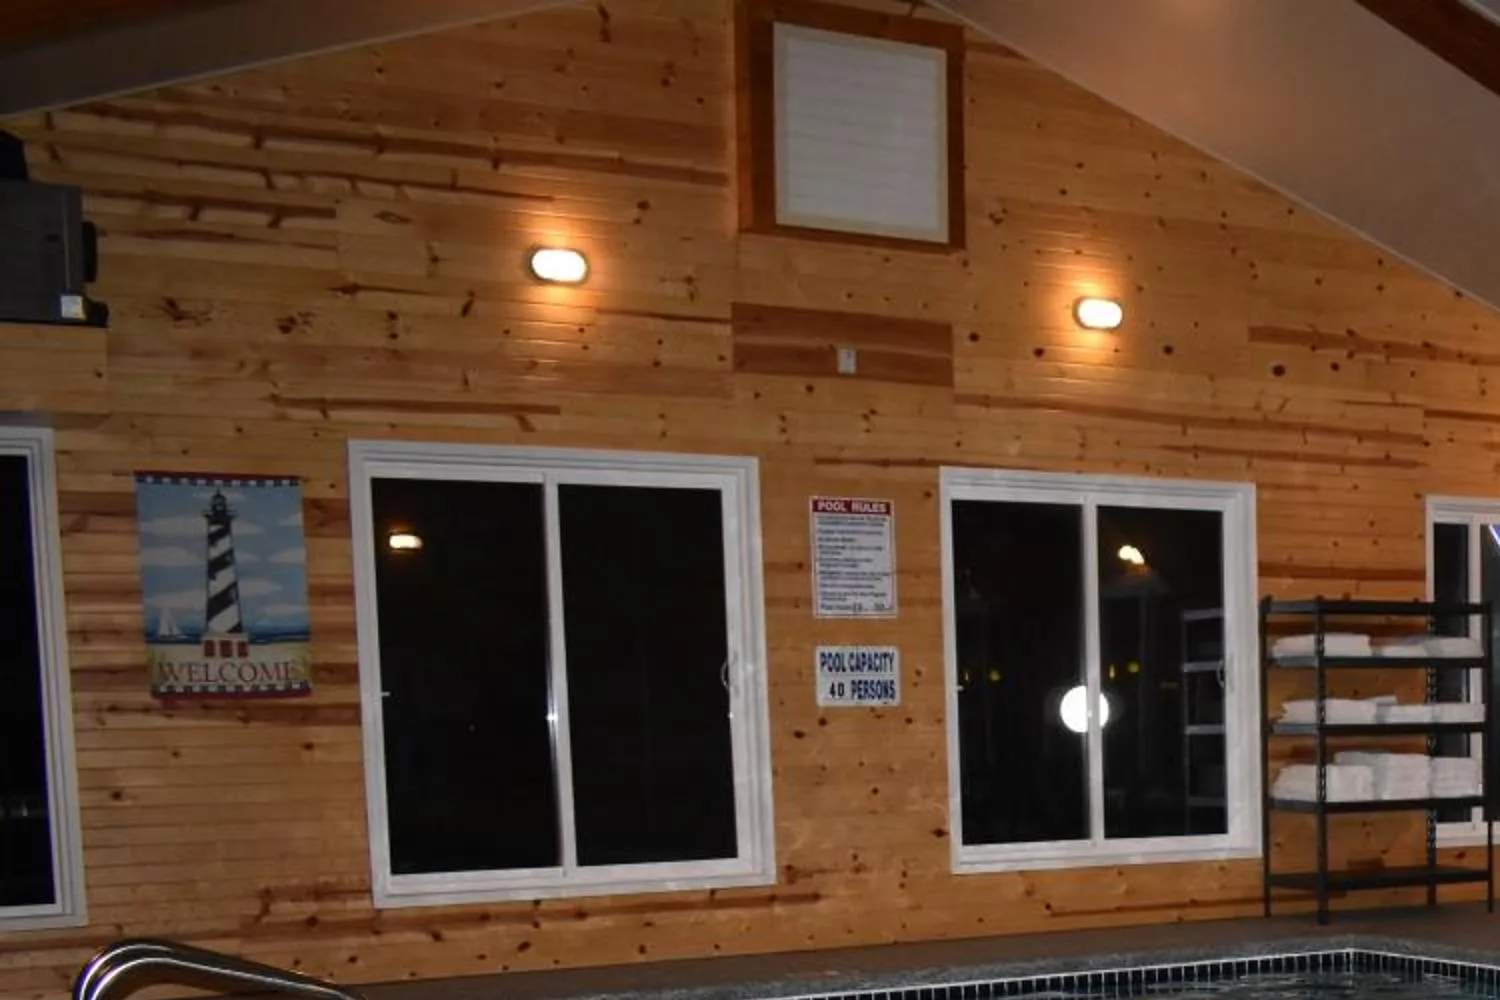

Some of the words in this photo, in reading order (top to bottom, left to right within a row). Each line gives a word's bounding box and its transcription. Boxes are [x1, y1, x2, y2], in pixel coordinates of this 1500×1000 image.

[817, 501, 847, 512] POOL
[851, 502, 886, 513] RULES
[158, 661, 299, 683] WELCOME
[820, 652, 846, 673] POOL
[849, 652, 895, 673] CAPACITY
[850, 679, 896, 700] PERSONS
